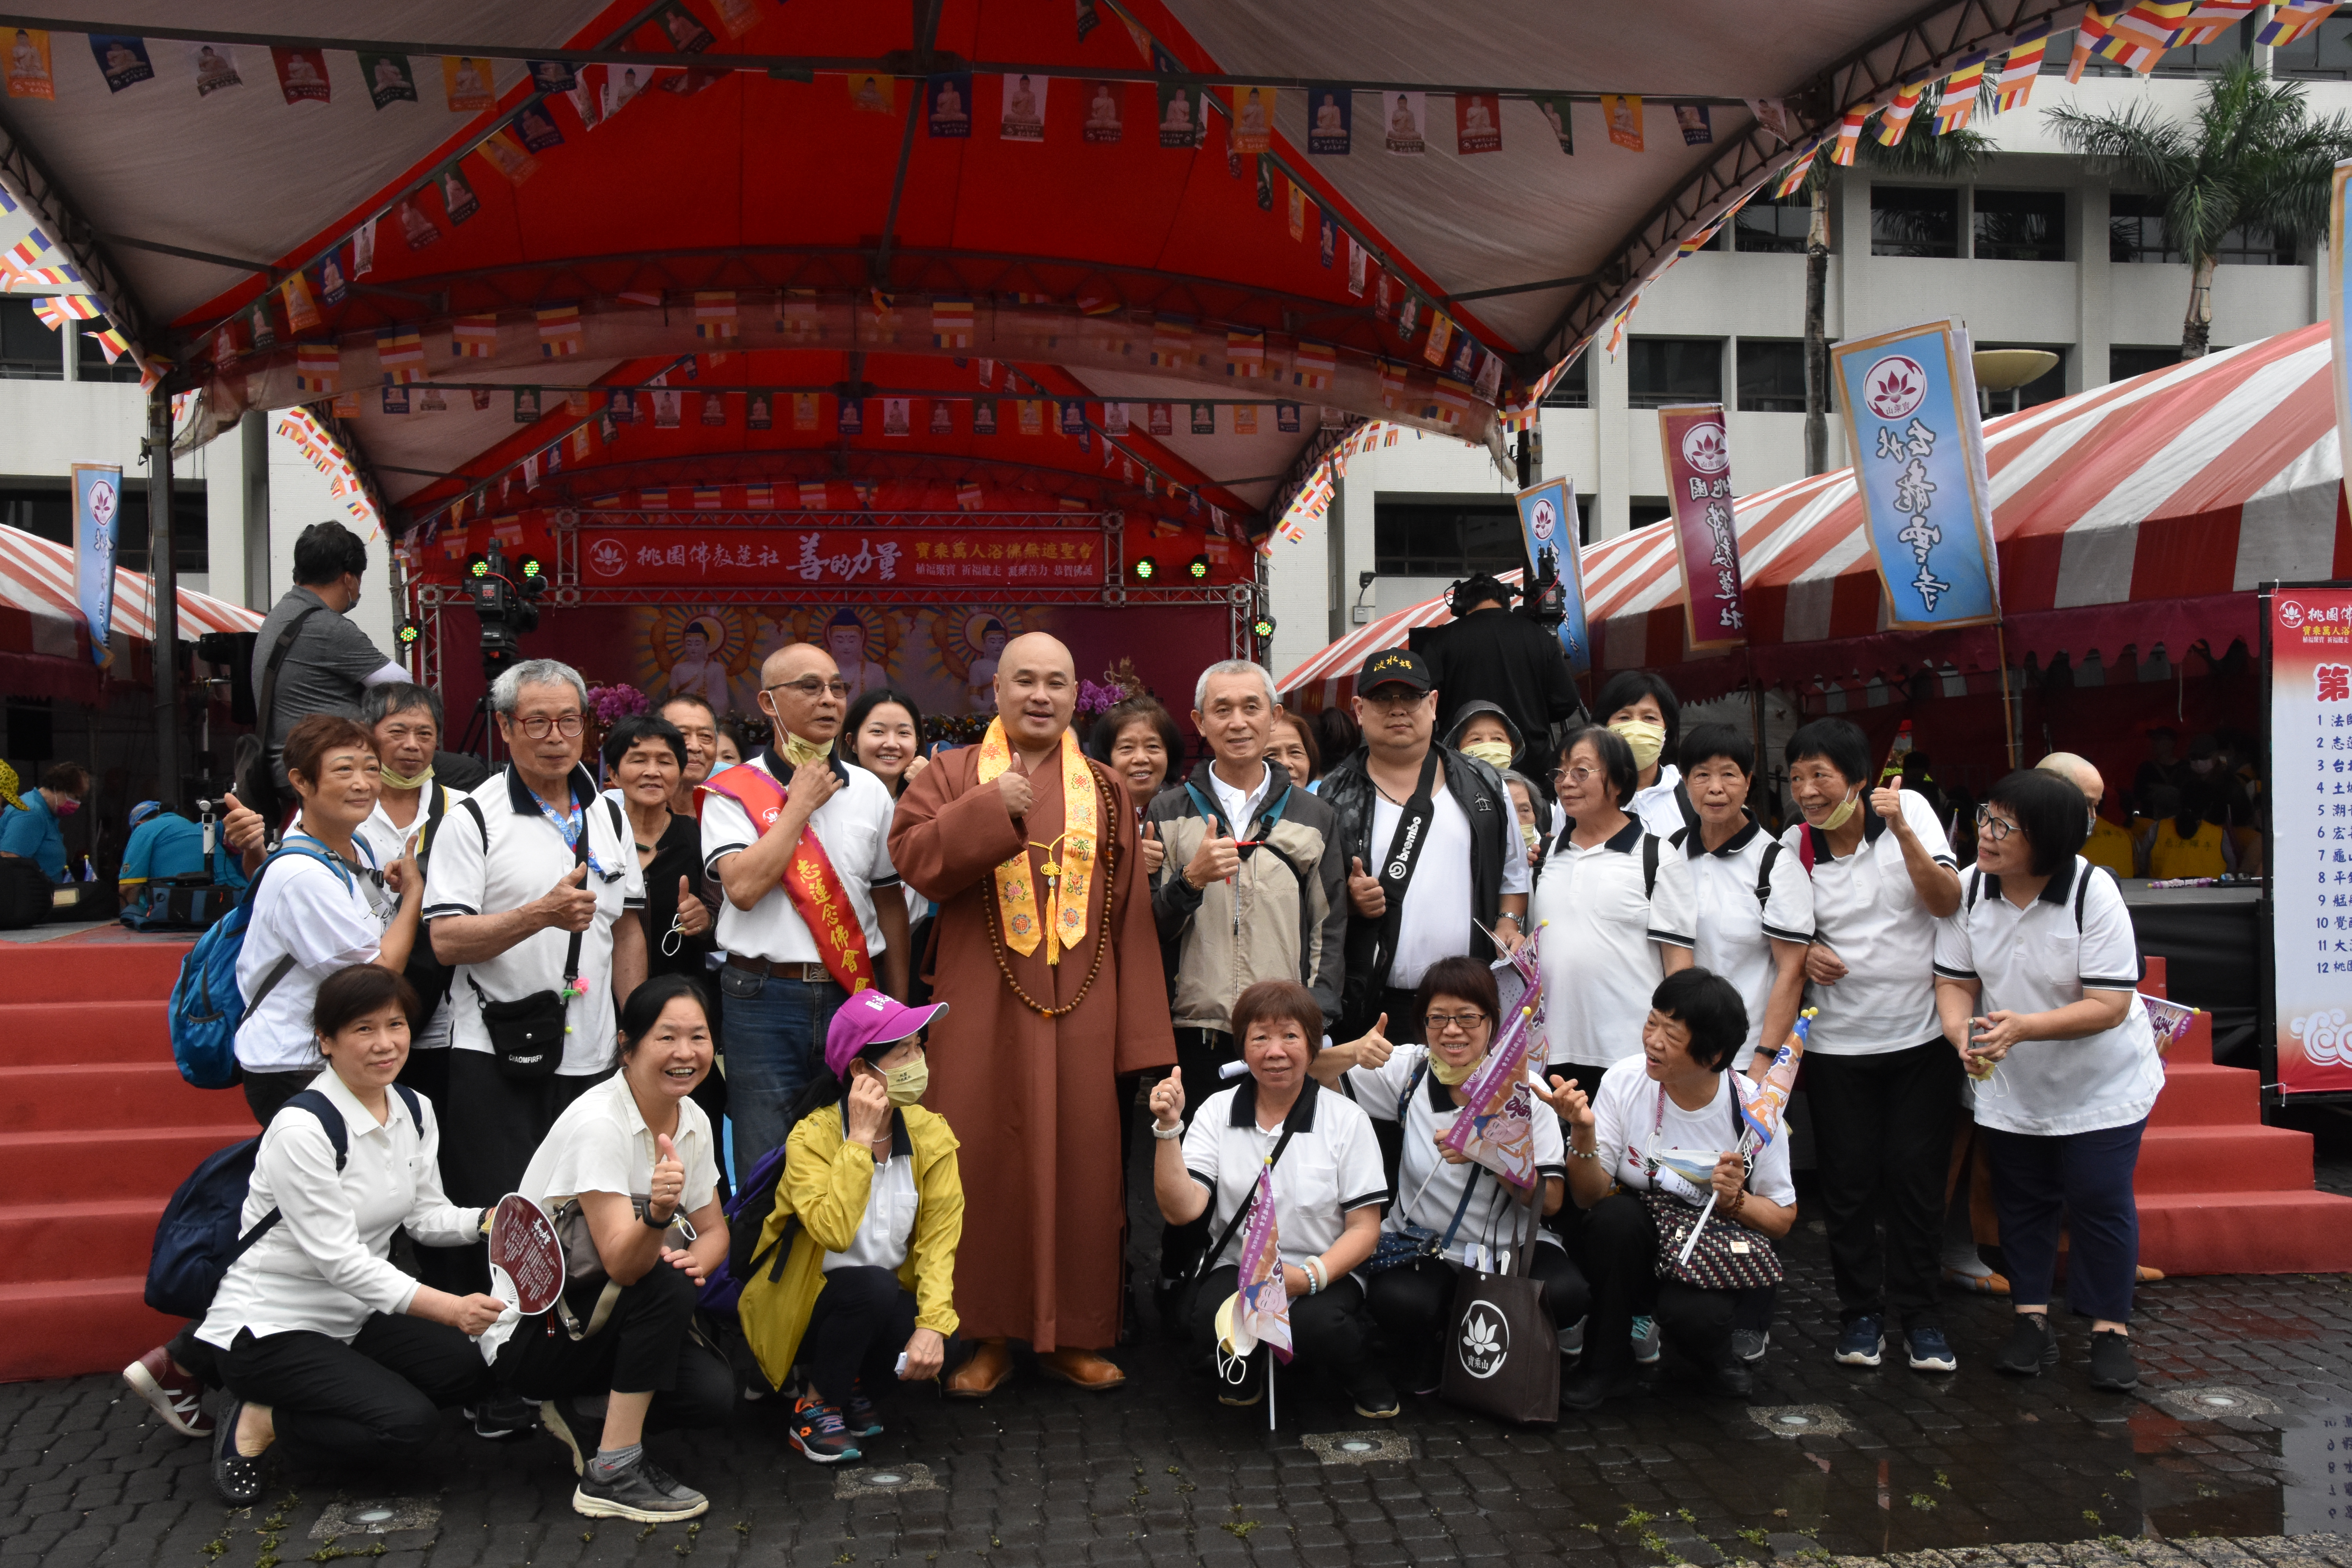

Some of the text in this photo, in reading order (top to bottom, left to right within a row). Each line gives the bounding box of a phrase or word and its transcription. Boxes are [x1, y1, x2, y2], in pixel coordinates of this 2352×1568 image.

[786, 532, 902, 581] 善的力量
[915, 542, 1094, 559] 寶乘萬人浴佛無遮聖會
[637, 541, 780, 575] 桃園佛教蓮社
[2316, 666, 2350, 702] 第
[2318, 714, 2322, 726] 1
[2316, 737, 2324, 748] 2
[2318, 759, 2324, 771] 3
[2316, 782, 2325, 794] 4
[2318, 804, 2325, 816] 5
[2318, 826, 2325, 838] 6
[1396, 817, 1421, 862] brembo
[2318, 849, 2325, 861] 7
[2318, 871, 2326, 884] 8
[2318, 895, 2326, 906] 9
[2316, 917, 2329, 929] 10
[2318, 939, 2327, 951] 11
[2317, 962, 2329, 974] 12
[1467, 1355, 1489, 1370] 寶乘山
